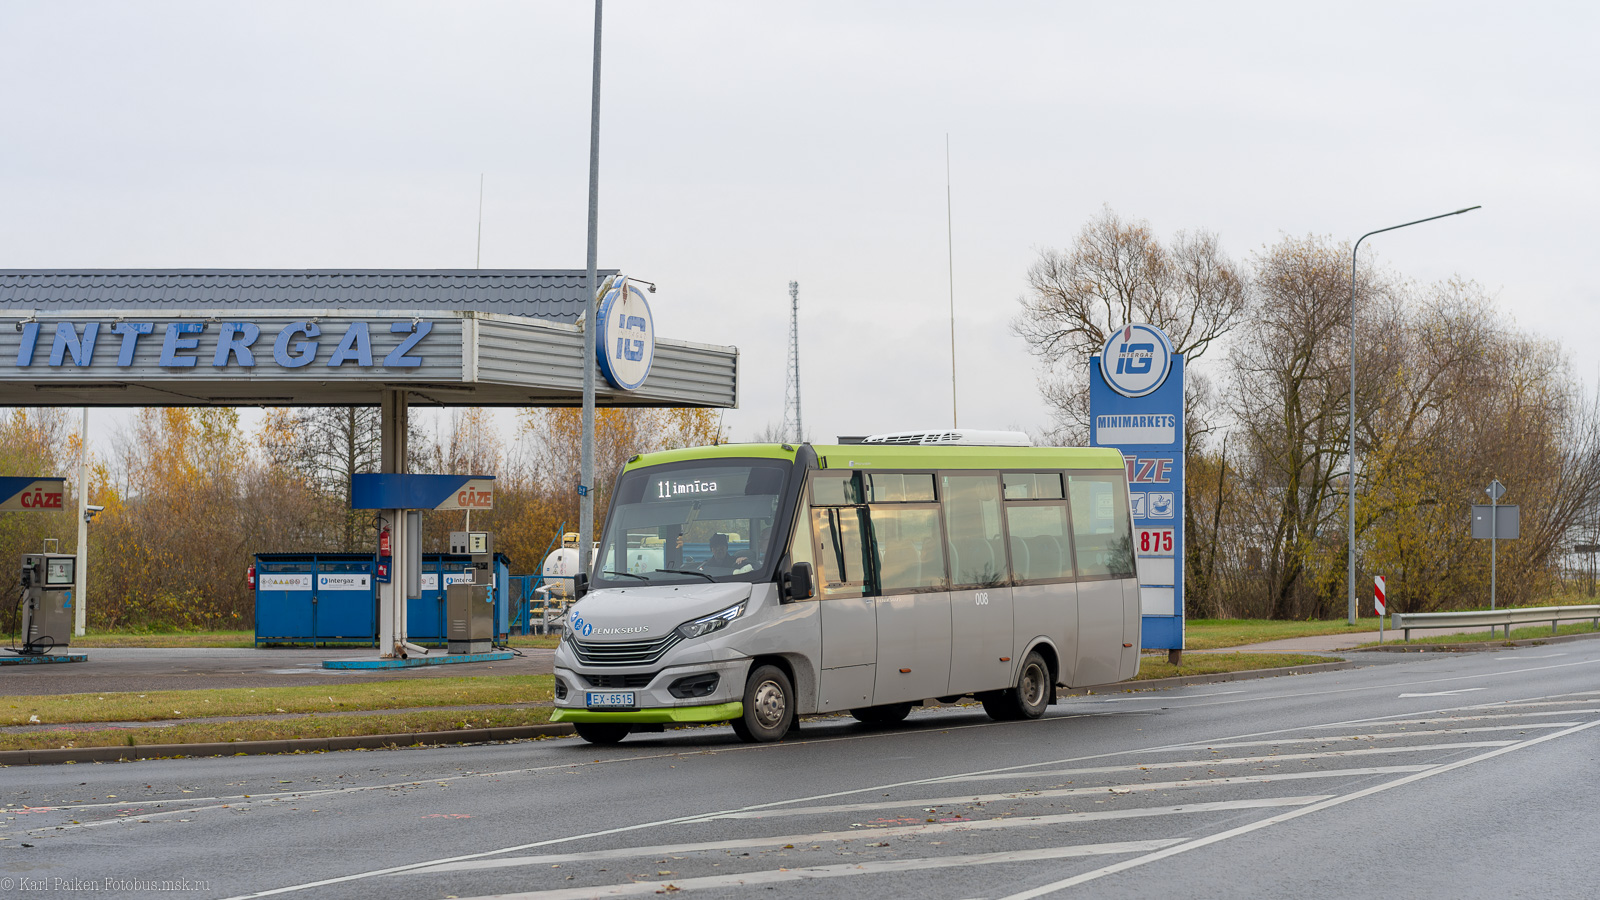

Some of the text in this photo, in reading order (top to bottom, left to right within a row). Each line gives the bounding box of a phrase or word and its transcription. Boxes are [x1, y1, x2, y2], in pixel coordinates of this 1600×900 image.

[15, 322, 433, 368] INTERGAZ
[1097, 414, 1175, 428] MINIMARKETS
[21, 488, 62, 508] GĀZE
[458, 487, 491, 507] GĀZE
[658, 481, 671, 498] 11
[1136, 531, 1173, 552] .875
[63, 591, 72, 608] 2
[485, 585, 493, 603] 3
[975, 592, 989, 606] 008
[592, 625, 649, 635] FENIKSBUS
[593, 694, 633, 705] EX-6515
